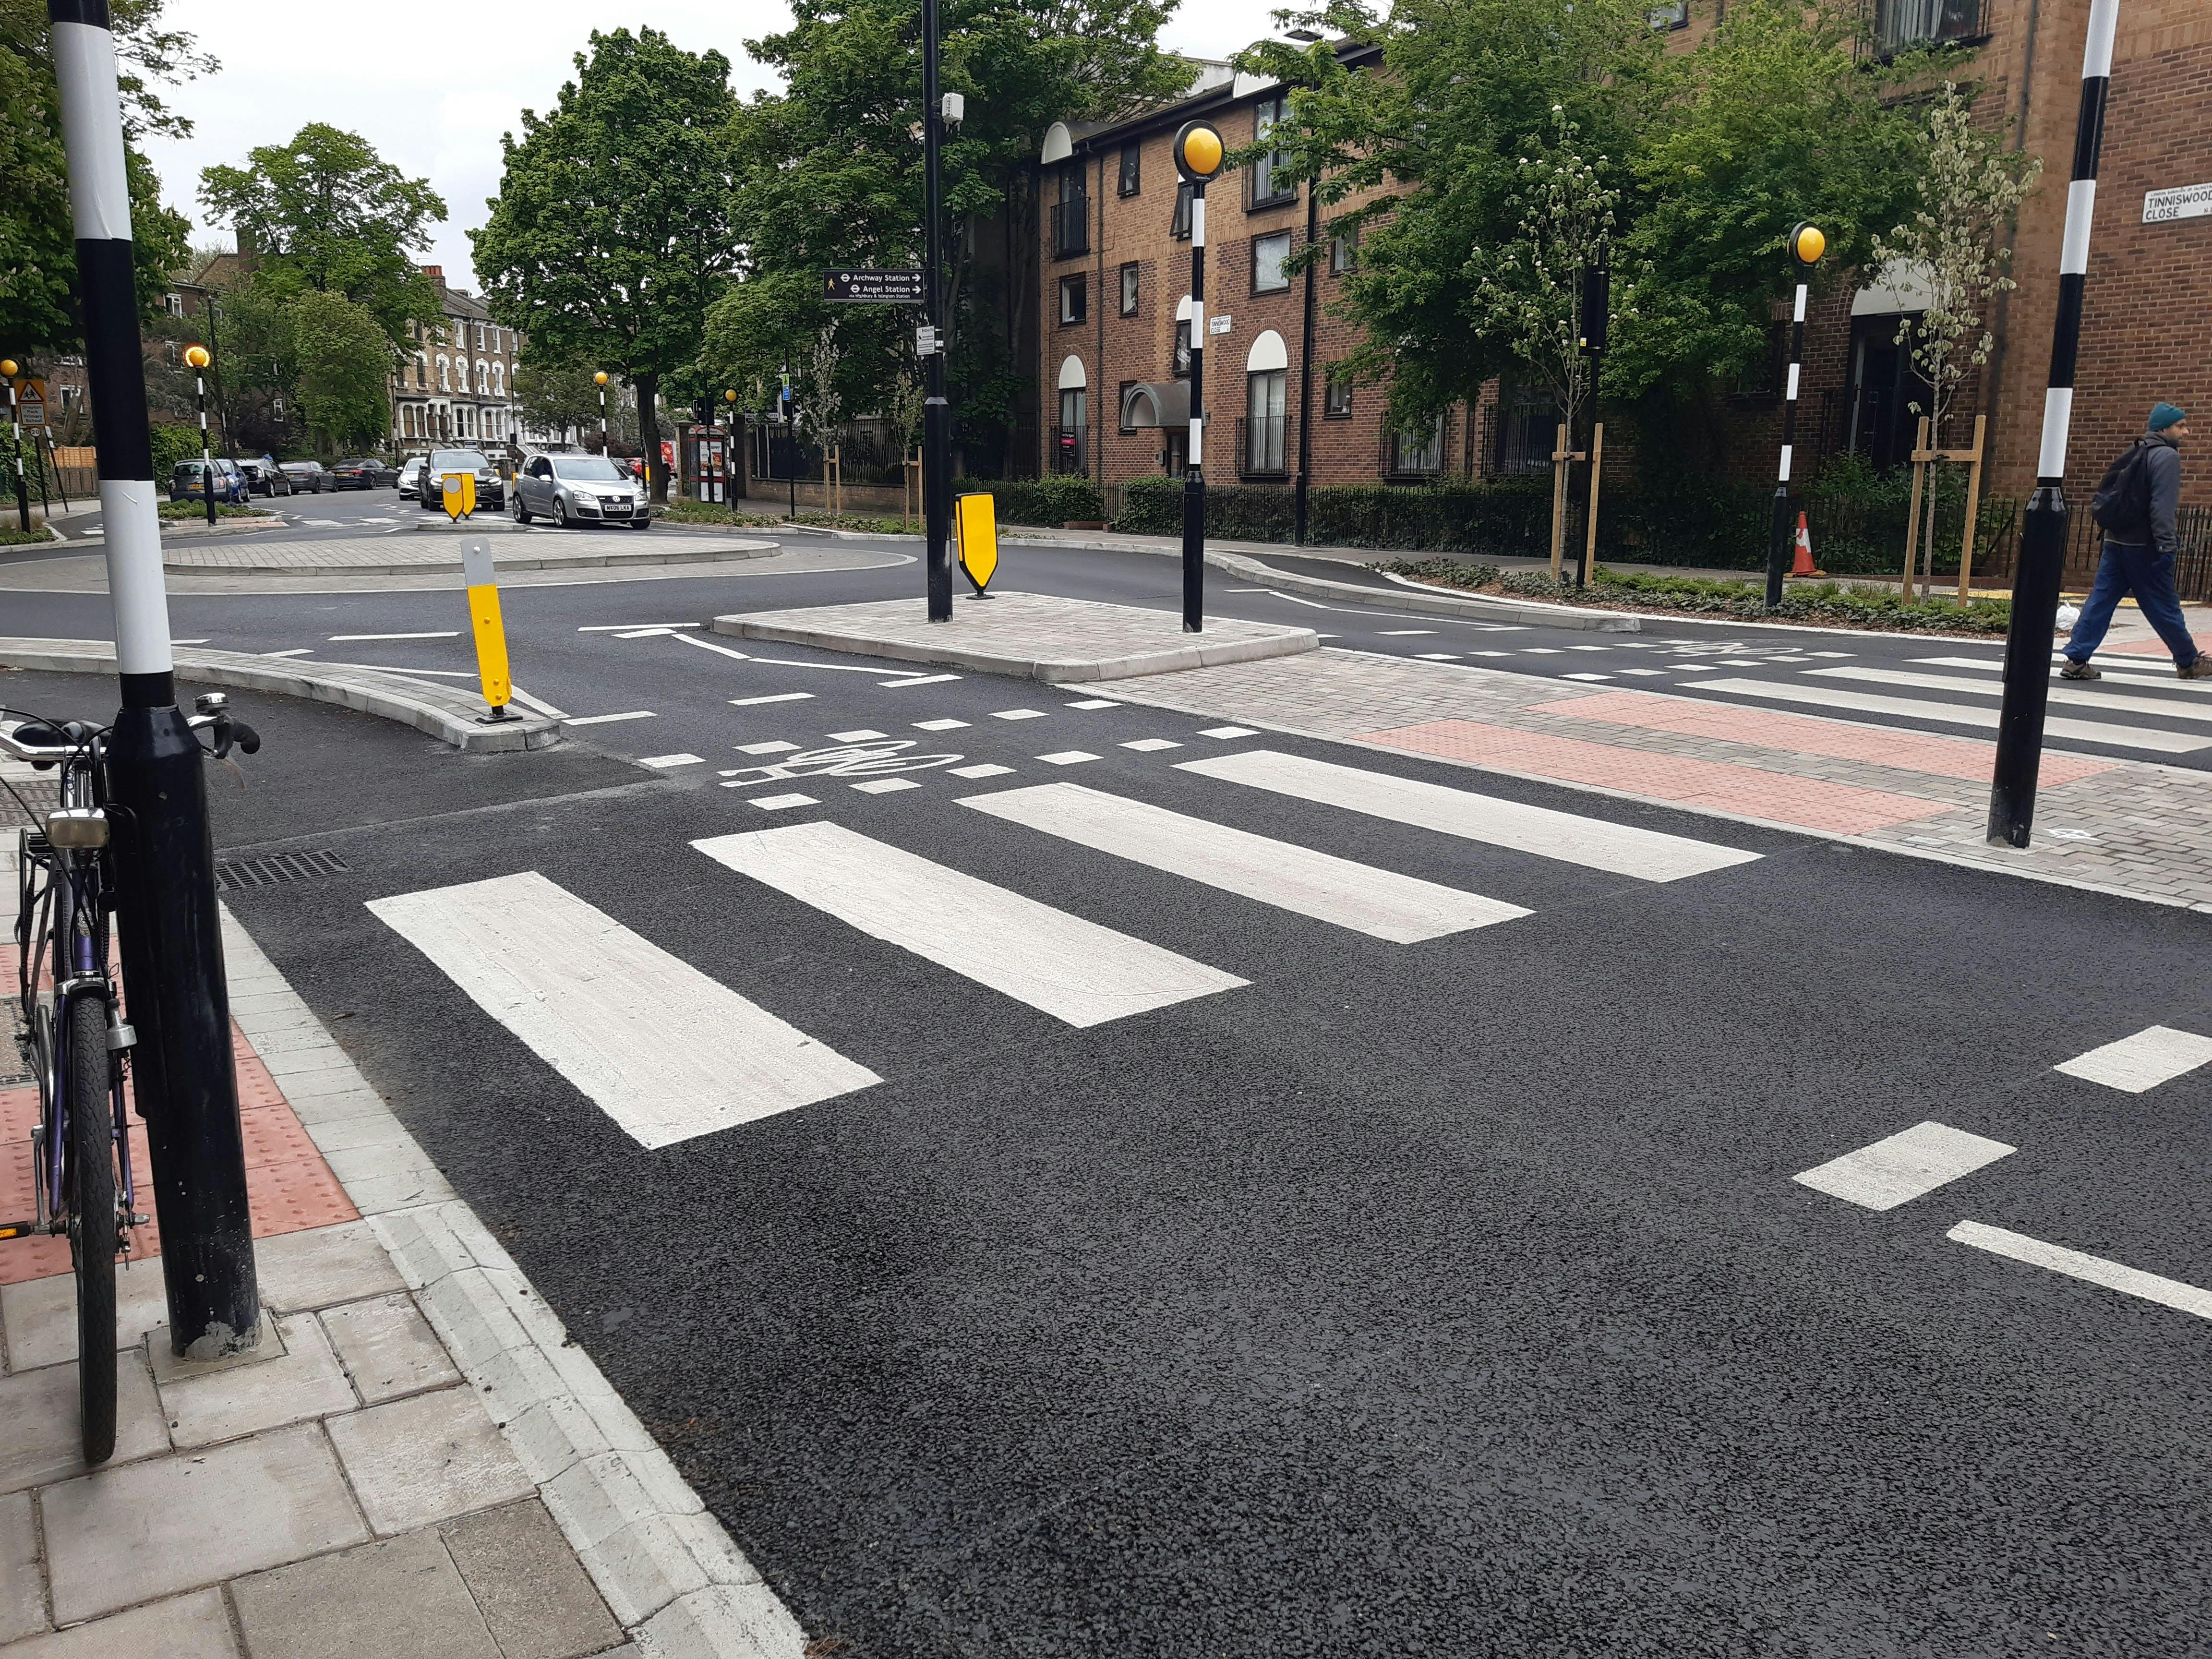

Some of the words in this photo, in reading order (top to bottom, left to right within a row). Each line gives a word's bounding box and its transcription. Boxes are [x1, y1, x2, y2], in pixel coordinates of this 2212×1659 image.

[2148, 191, 2212, 208] TINNISWOOD
[2146, 206, 2179, 220] CLOSE
[853, 274, 882, 282] Archway
[863, 285, 883, 293] Angel
